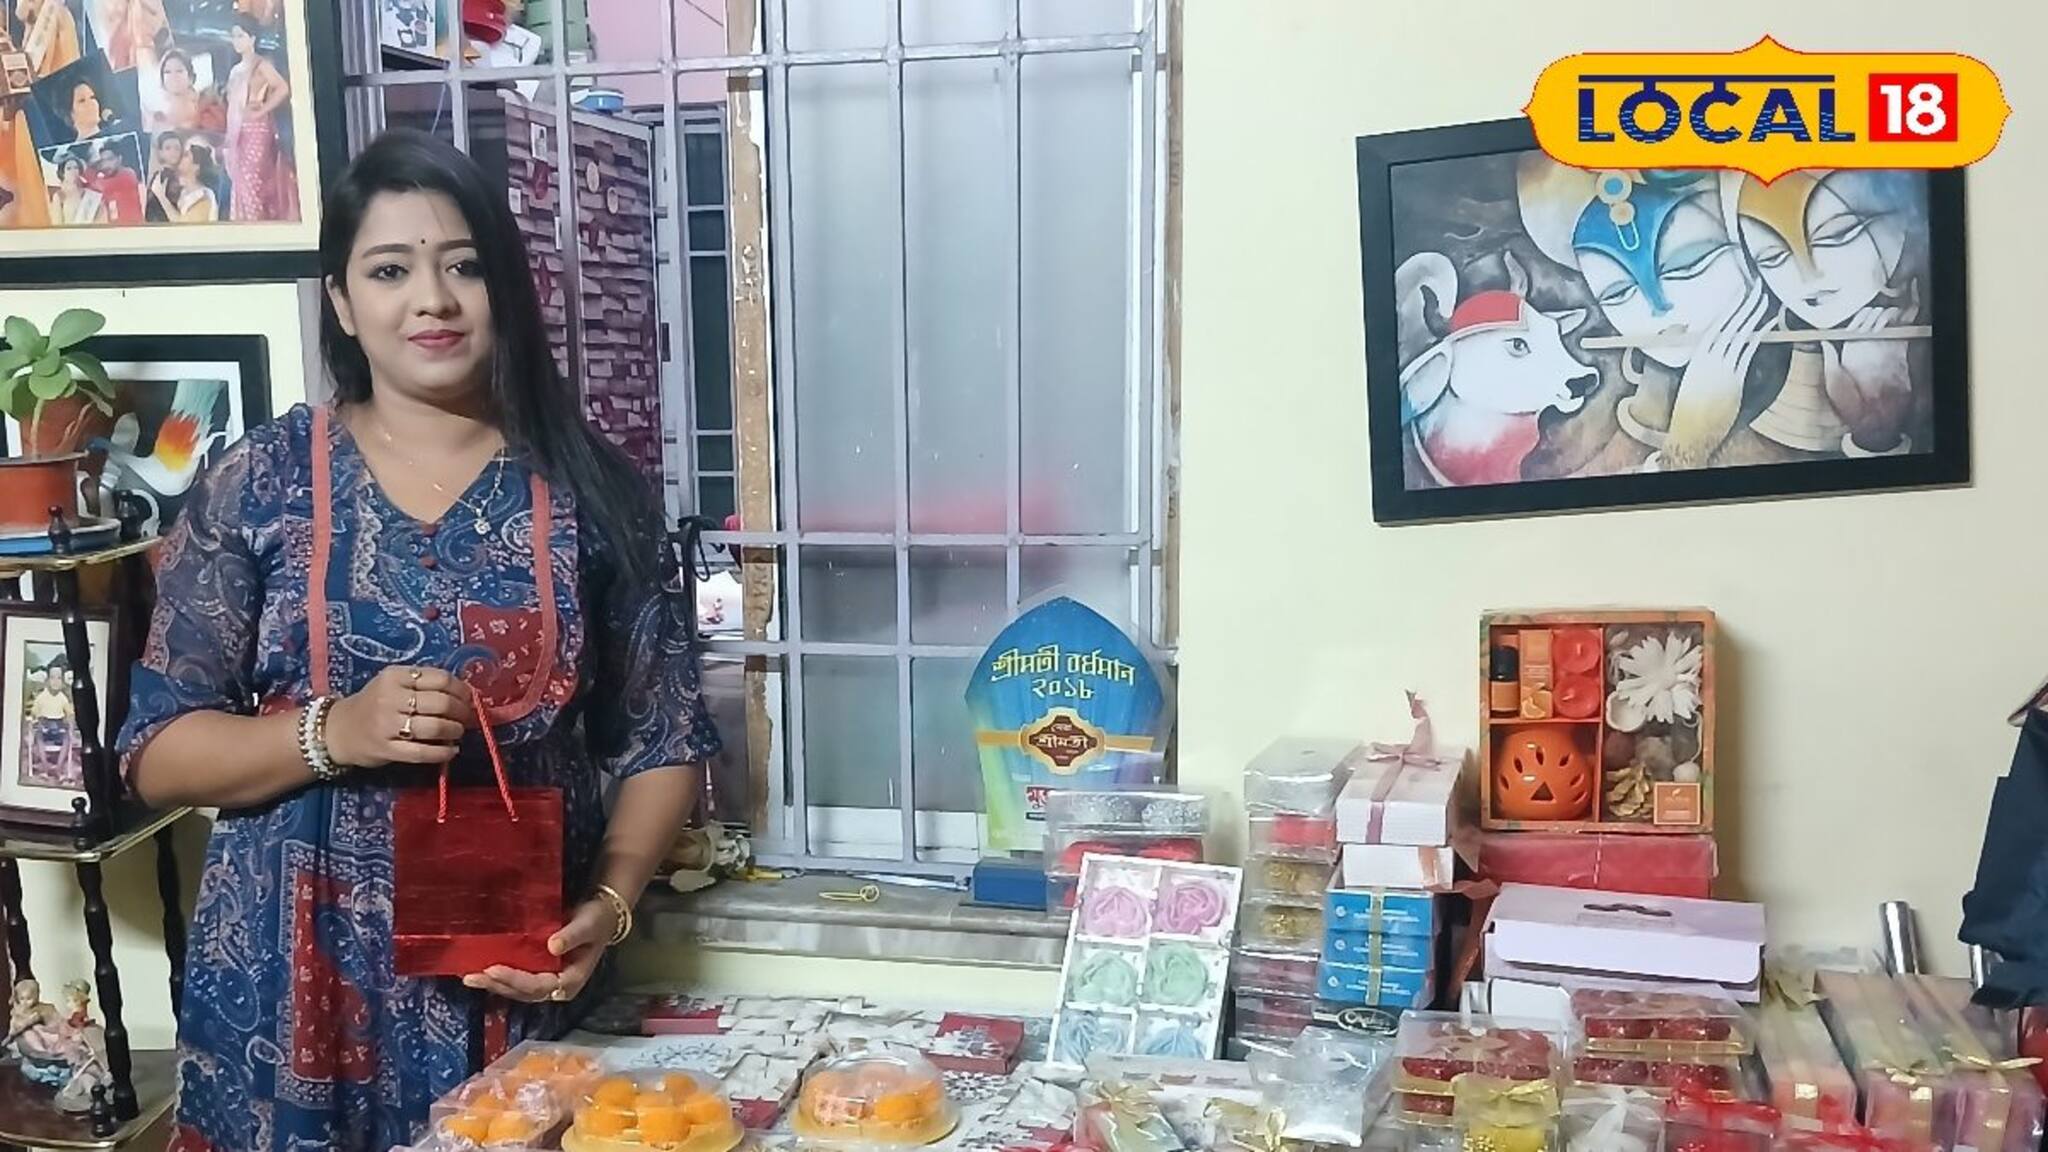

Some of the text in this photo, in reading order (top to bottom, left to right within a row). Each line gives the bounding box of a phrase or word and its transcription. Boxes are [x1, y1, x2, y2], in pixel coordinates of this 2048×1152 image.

[991, 644, 1136, 687] শ্রীমতী বর্ধমান
[1031, 677, 1095, 699] ২০১৮
